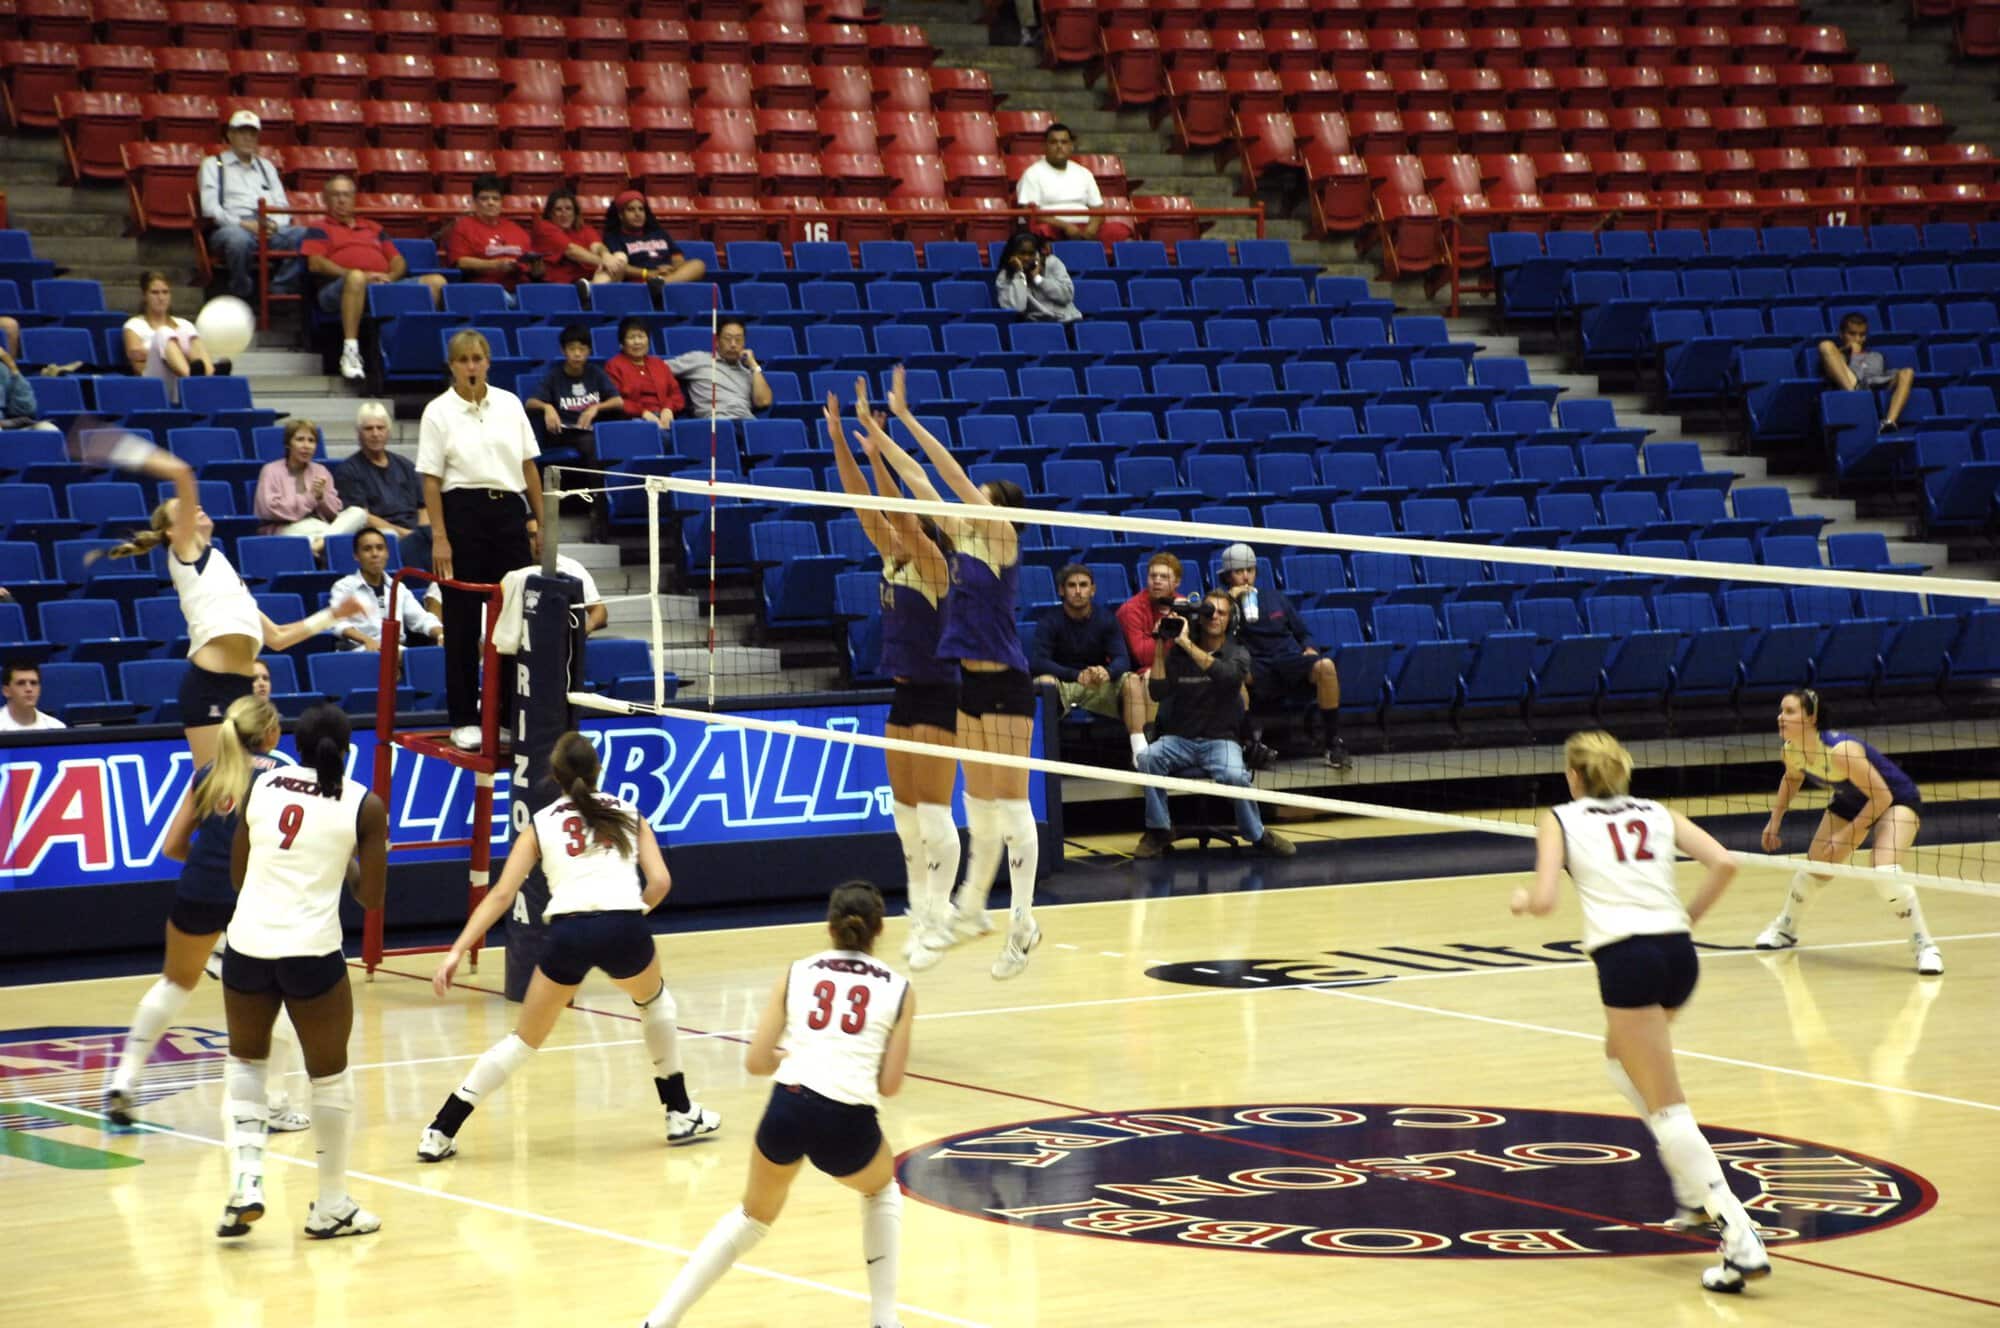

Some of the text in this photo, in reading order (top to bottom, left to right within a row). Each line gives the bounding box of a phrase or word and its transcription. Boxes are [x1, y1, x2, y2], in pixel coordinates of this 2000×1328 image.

[804, 221, 829, 242] 16
[1827, 211, 1847, 227] 17
[560, 391, 600, 410] ARIZON
[266, 775, 342, 801] ARIZOA
[512, 618, 532, 925] ARIZOA
[278, 804, 304, 850] 9
[1606, 819, 1654, 863] 12
[808, 980, 871, 1035] 33
[928, 1107, 1506, 1168] COURT
[1094, 1142, 1641, 1206] OLSON
[983, 1198, 1608, 1254] BOBBI
